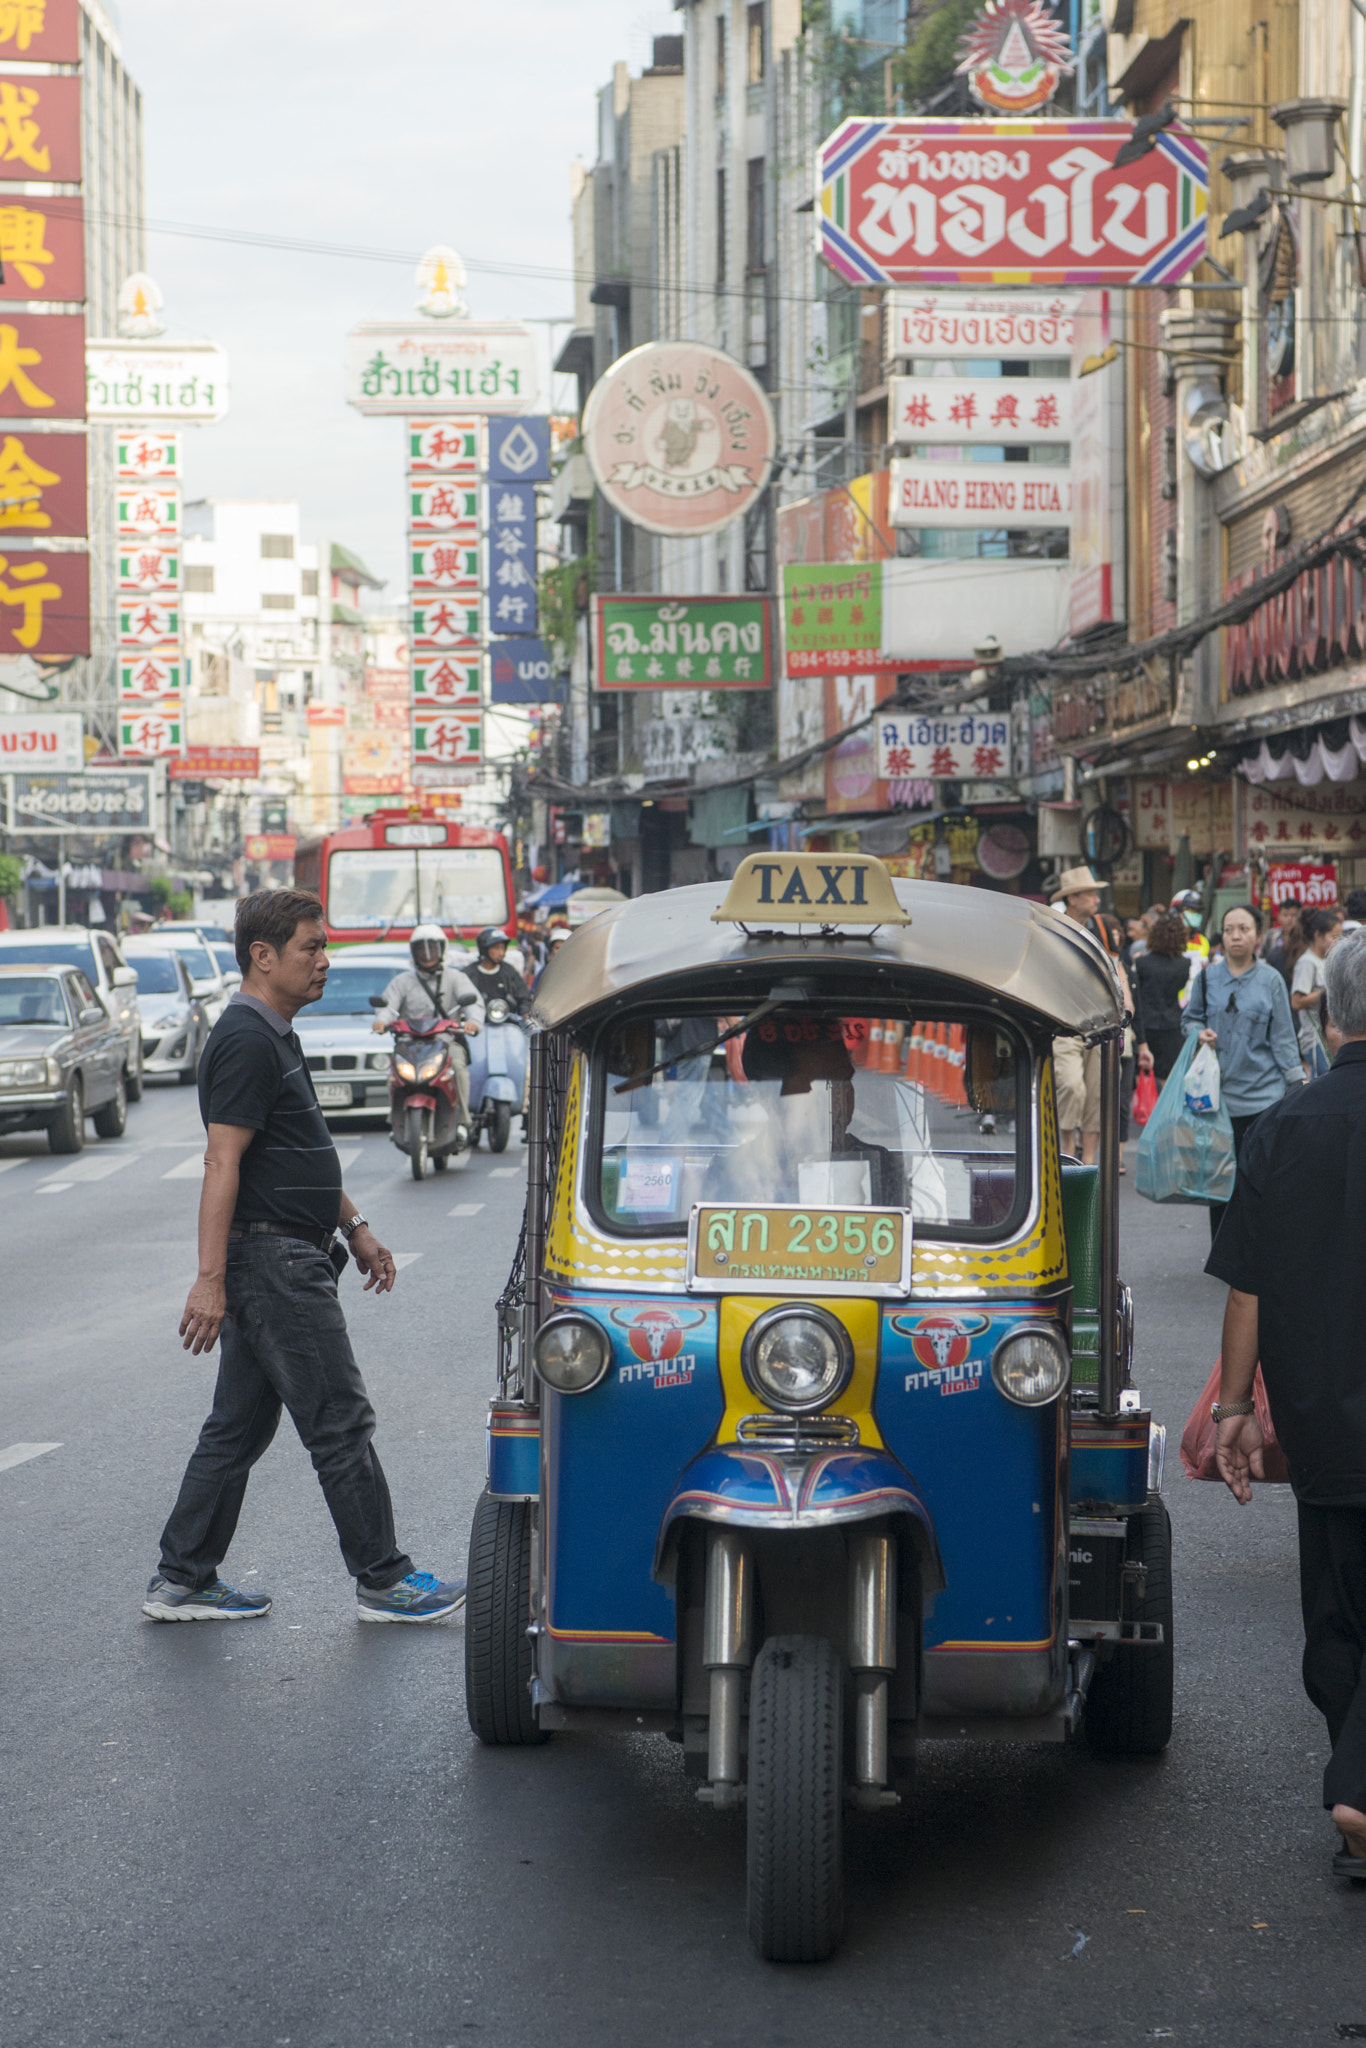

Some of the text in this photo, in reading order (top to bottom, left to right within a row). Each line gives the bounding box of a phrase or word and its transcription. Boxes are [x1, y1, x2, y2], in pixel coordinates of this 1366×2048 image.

[877, 137, 1030, 181] ห้างทอง
[903, 479, 1062, 511] SIANG HENG HUA
[751, 864, 868, 905] TAXI
[644, 1174, 672, 1187] 2560
[707, 1210, 895, 1256] สก 2356
[728, 1263, 869, 1281] กรงเทพมหานคร
[619, 1353, 696, 1384] คาราบาว
[654, 1371, 691, 1389] แดง
[905, 1360, 982, 1393] คาราบาว
[941, 1377, 979, 1396] แดง
